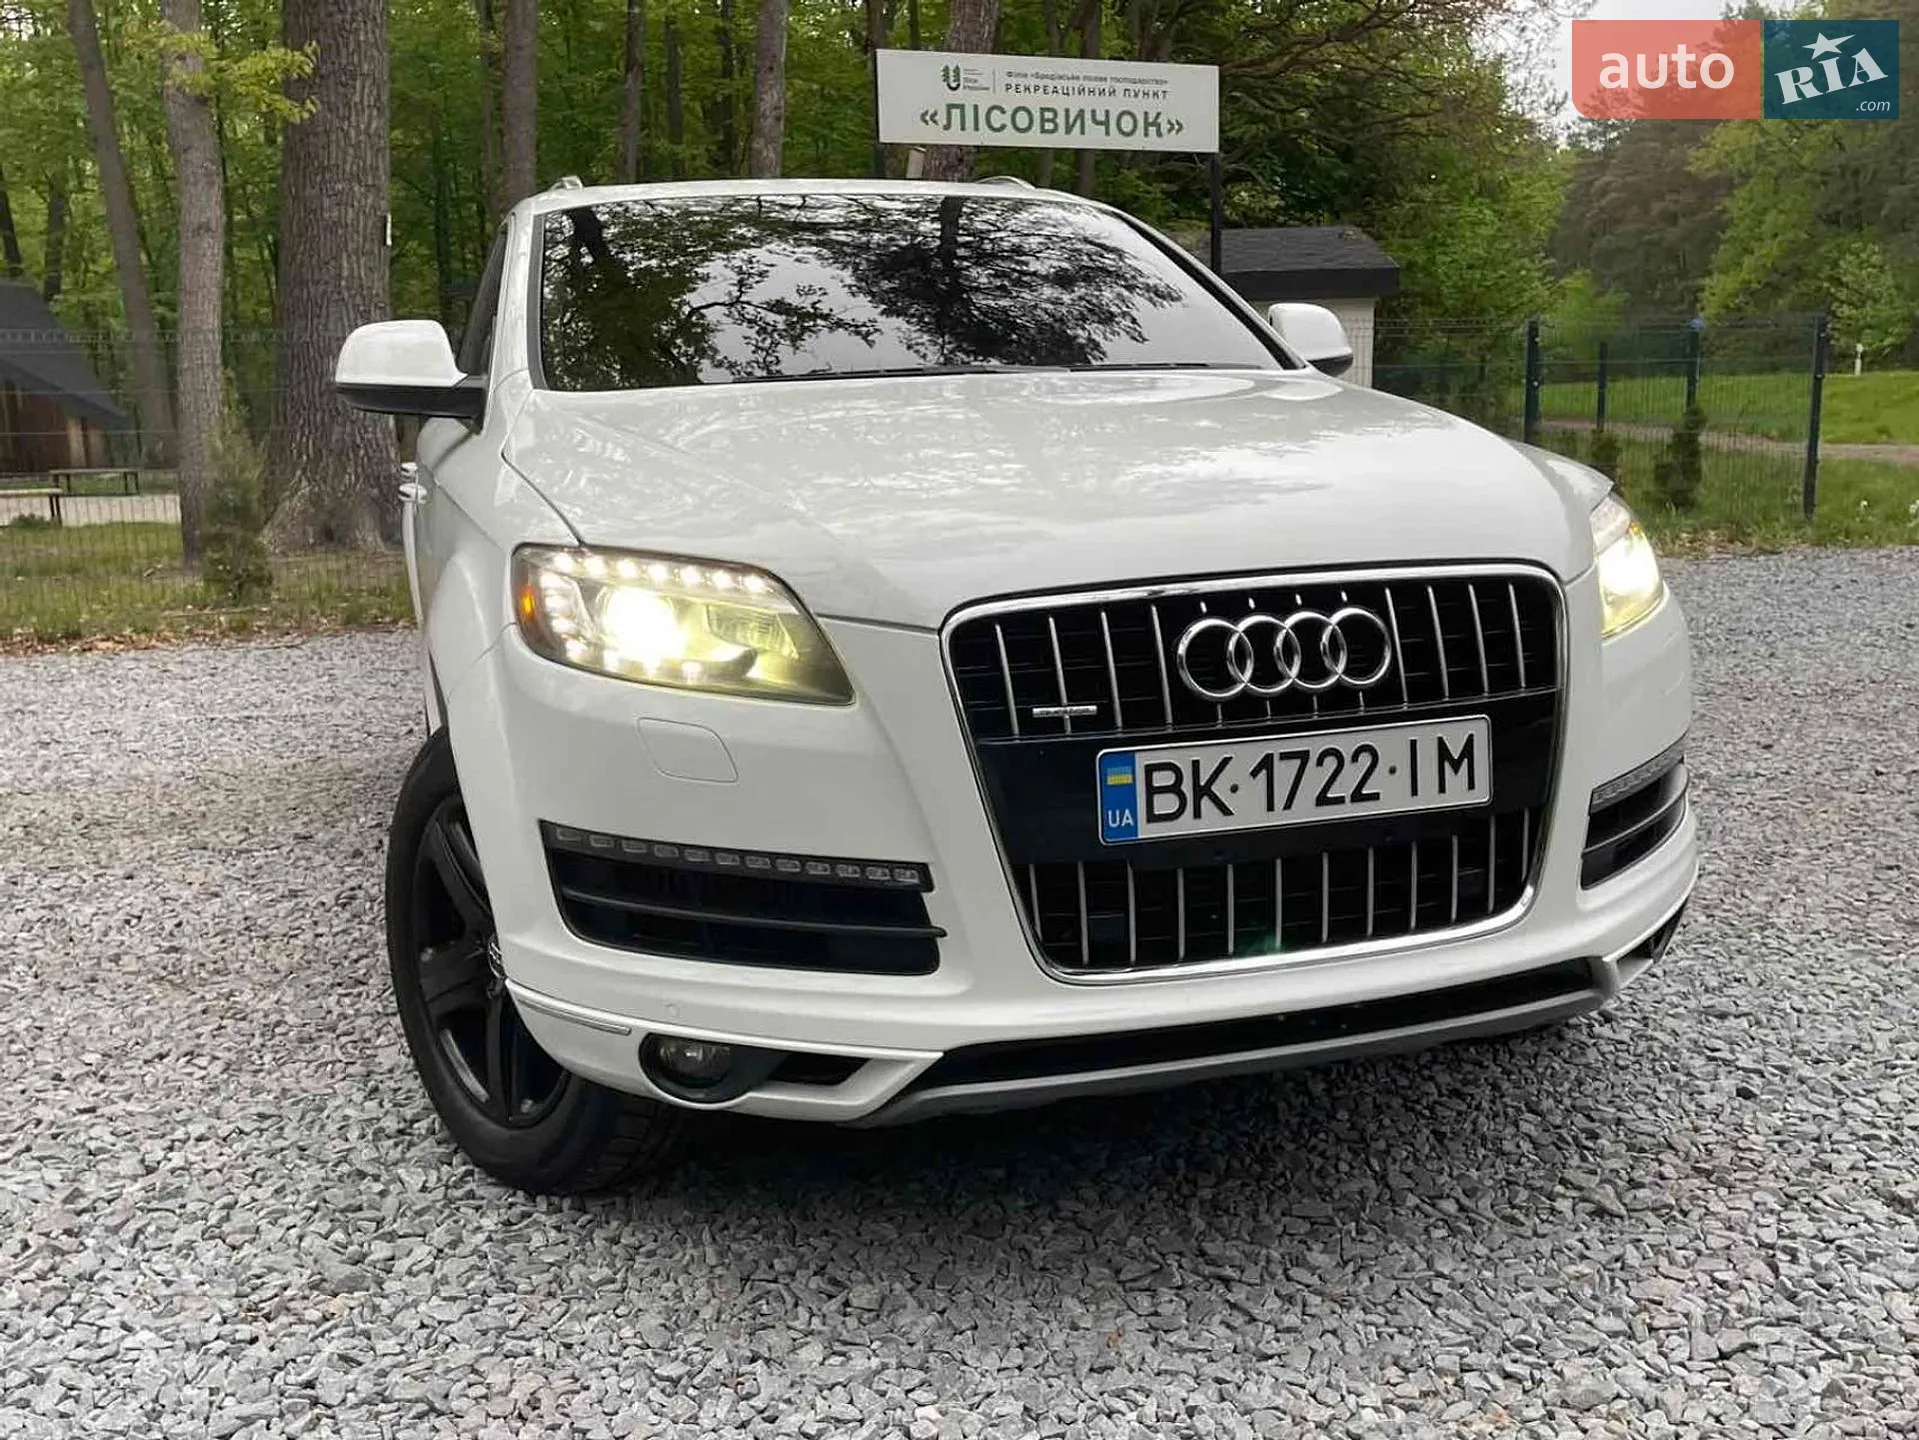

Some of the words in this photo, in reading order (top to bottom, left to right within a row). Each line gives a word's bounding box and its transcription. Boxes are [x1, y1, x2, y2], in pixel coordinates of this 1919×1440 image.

[1005, 83, 1117, 97] РЕКРЕАЦІЙНИЙ
[1123, 88, 1168, 100] ПУНКТ
[919, 103, 1184, 138] «ЛІСОВИЧОК»
[1249, 743, 1381, 812] 1722
[1107, 810, 1134, 828] UA
